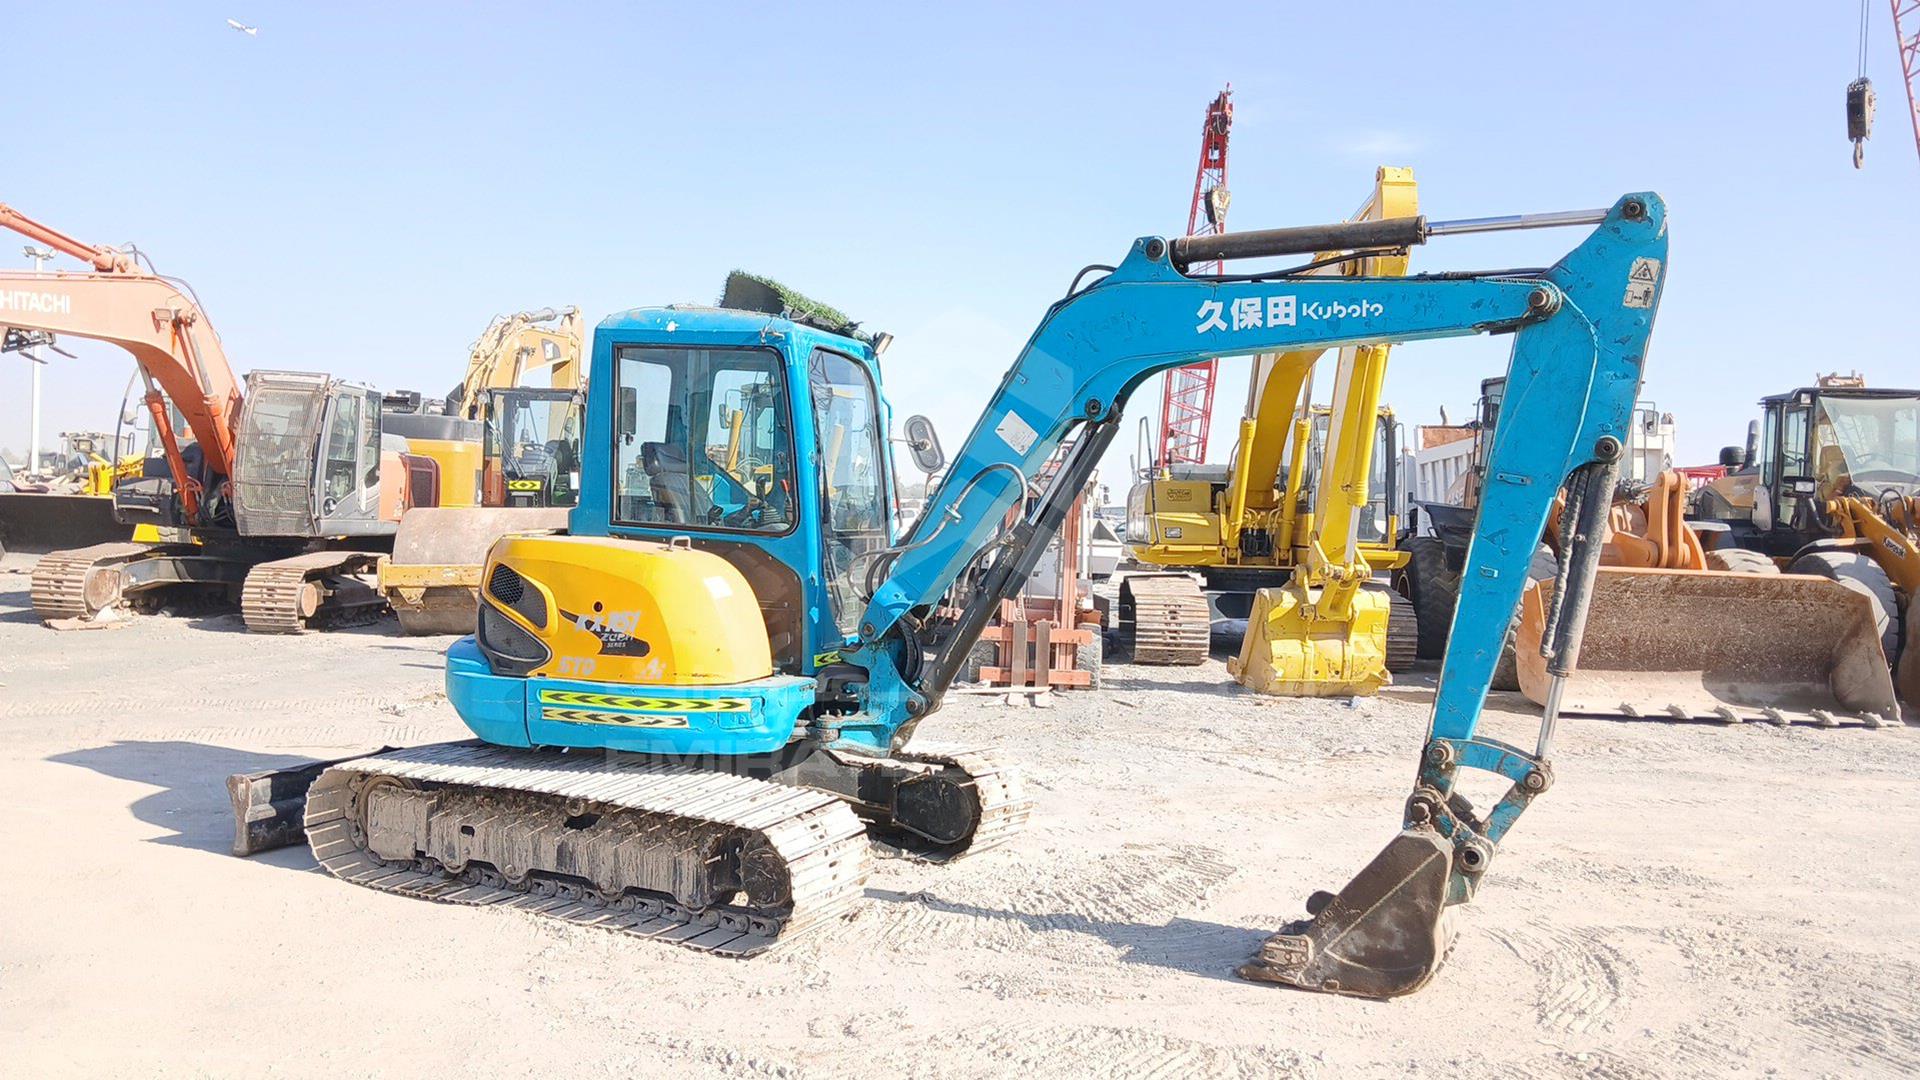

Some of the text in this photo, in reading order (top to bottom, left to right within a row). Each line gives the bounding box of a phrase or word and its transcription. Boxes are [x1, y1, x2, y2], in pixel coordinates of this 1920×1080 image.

[0, 289, 71, 314] HITACHI
[1195, 295, 1384, 334] 久保田 Kubota
